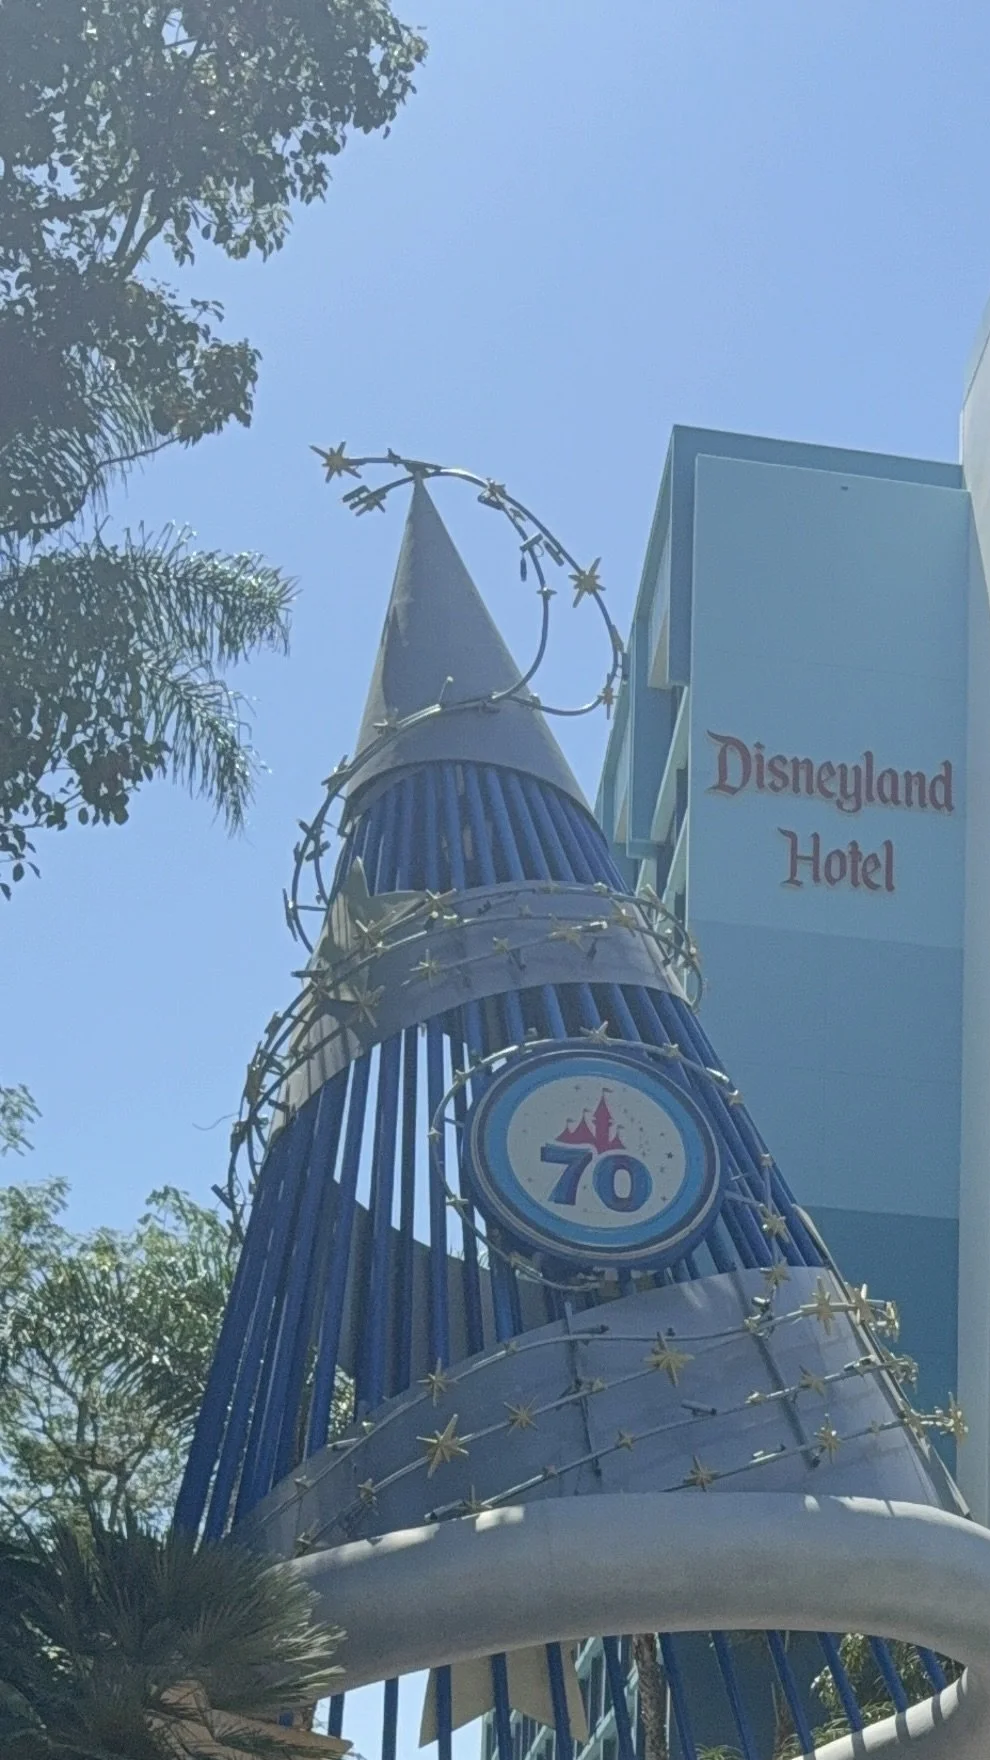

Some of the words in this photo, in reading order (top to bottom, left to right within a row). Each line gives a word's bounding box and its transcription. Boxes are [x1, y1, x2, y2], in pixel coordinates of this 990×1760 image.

[706, 729, 954, 814] Disneyland
[777, 827, 895, 892] Hotel
[540, 1142, 653, 1213] 70
